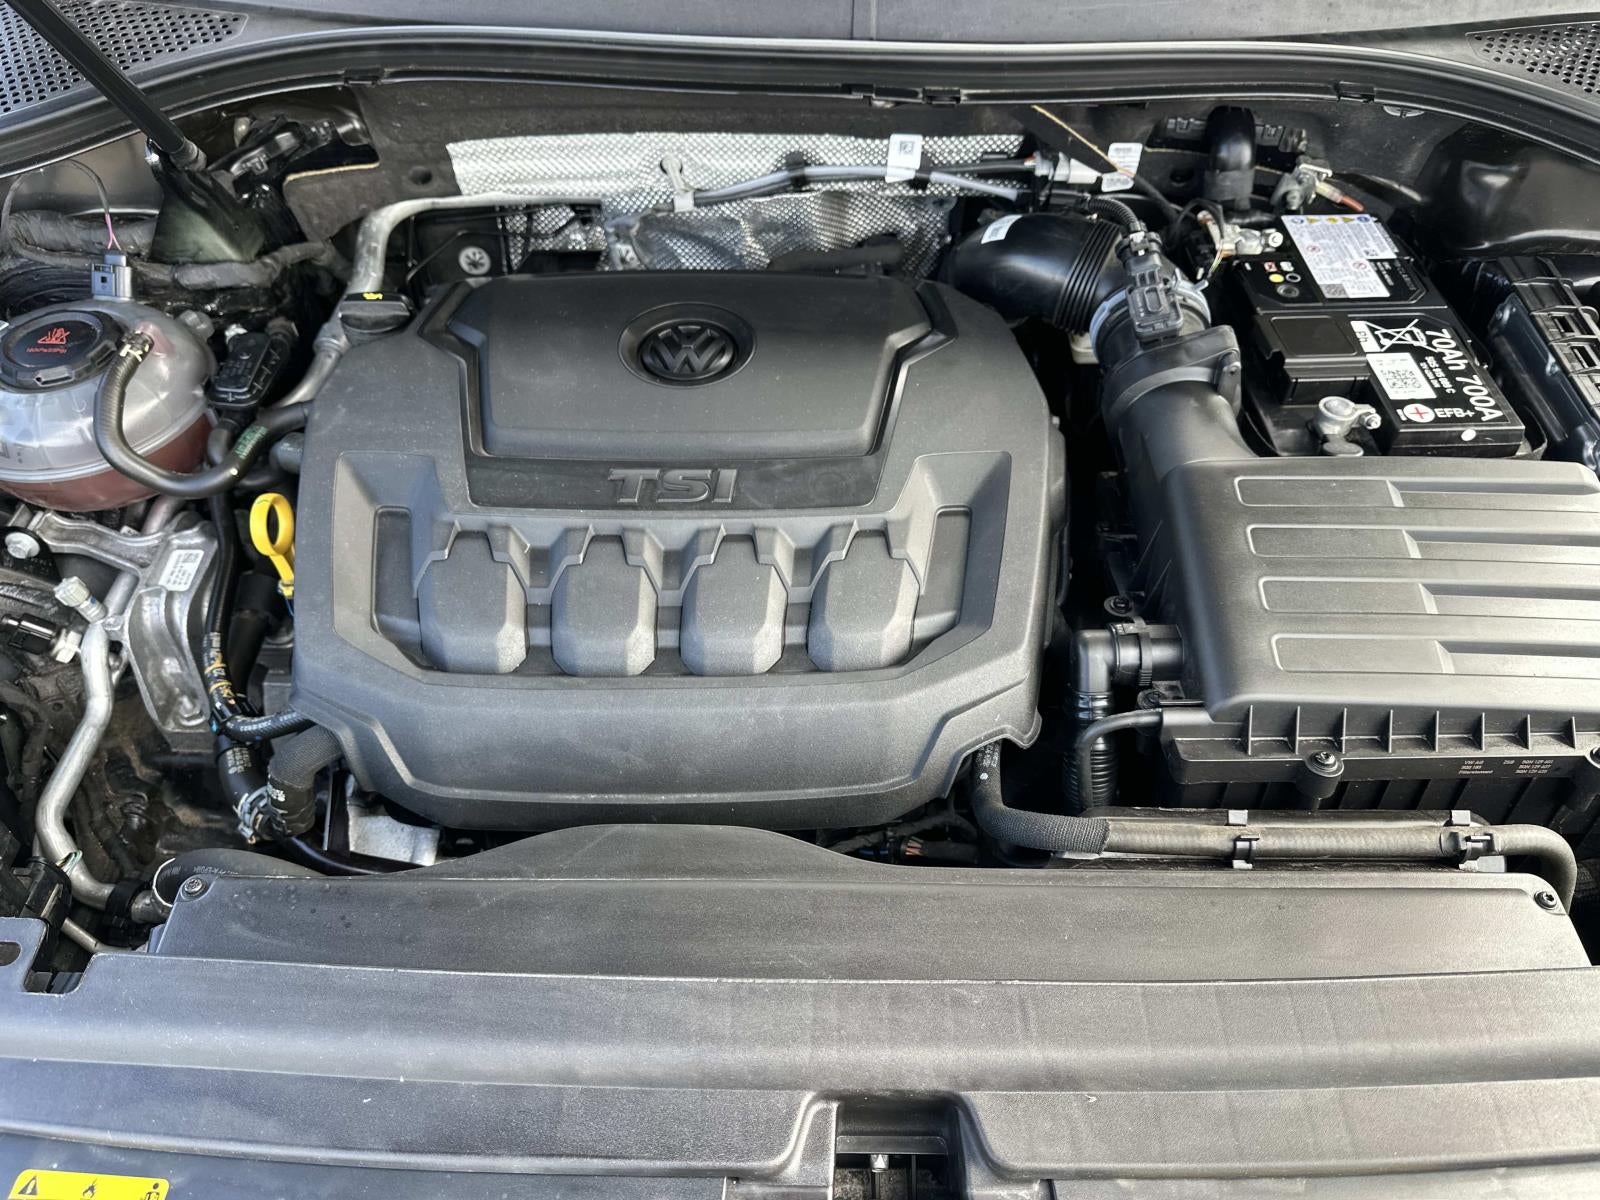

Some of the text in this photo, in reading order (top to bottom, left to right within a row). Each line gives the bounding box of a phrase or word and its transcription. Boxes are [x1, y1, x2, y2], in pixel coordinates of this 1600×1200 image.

[1425, 328, 1504, 422] 70Ah 700A
[1434, 407, 1475, 419] EFB+
[607, 468, 738, 503] TSI
